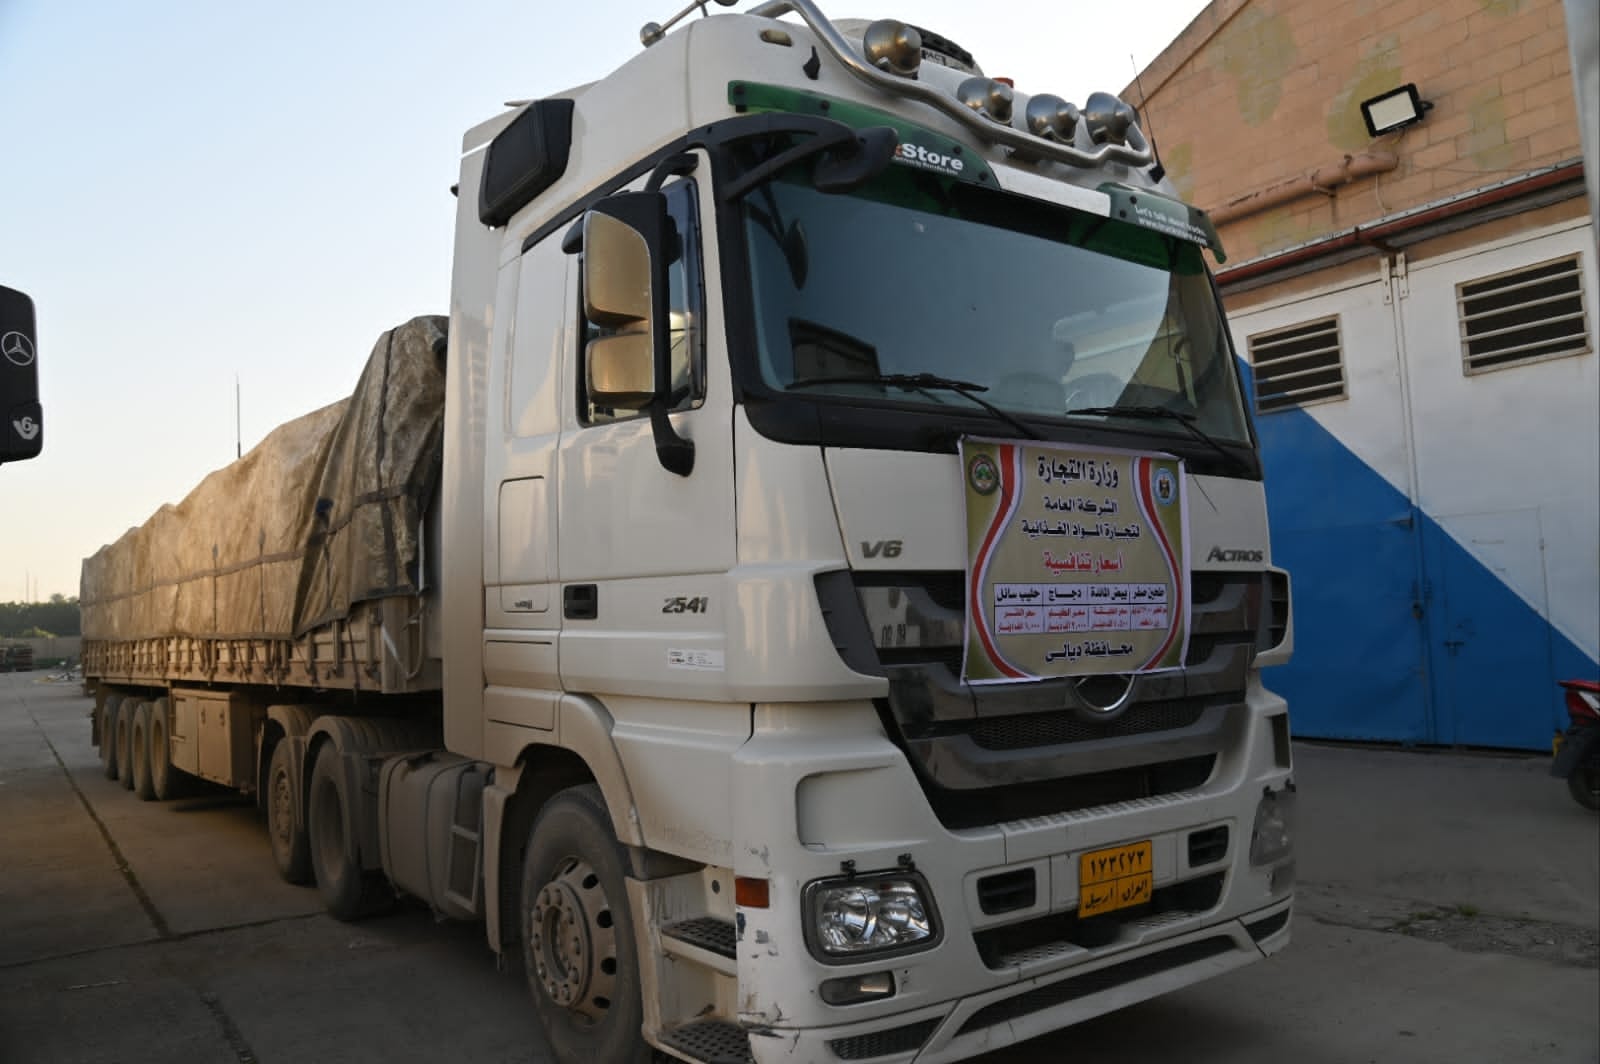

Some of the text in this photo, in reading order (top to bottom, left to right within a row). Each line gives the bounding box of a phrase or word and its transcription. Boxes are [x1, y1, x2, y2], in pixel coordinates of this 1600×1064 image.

[1038, 456, 1119, 488] وزارة التجارة
[1044, 496, 1118, 516] الشركة العامة
[1022, 519, 1140, 541] لتجارة المواد الغذائية
[860, 540, 903, 559] V6
[1044, 552, 1092, 575] تنافسية
[1019, 587, 1041, 602] حليب
[1049, 587, 1082, 602] دجاج
[662, 597, 709, 614] 2541
[1083, 640, 1133, 657] محافظة
